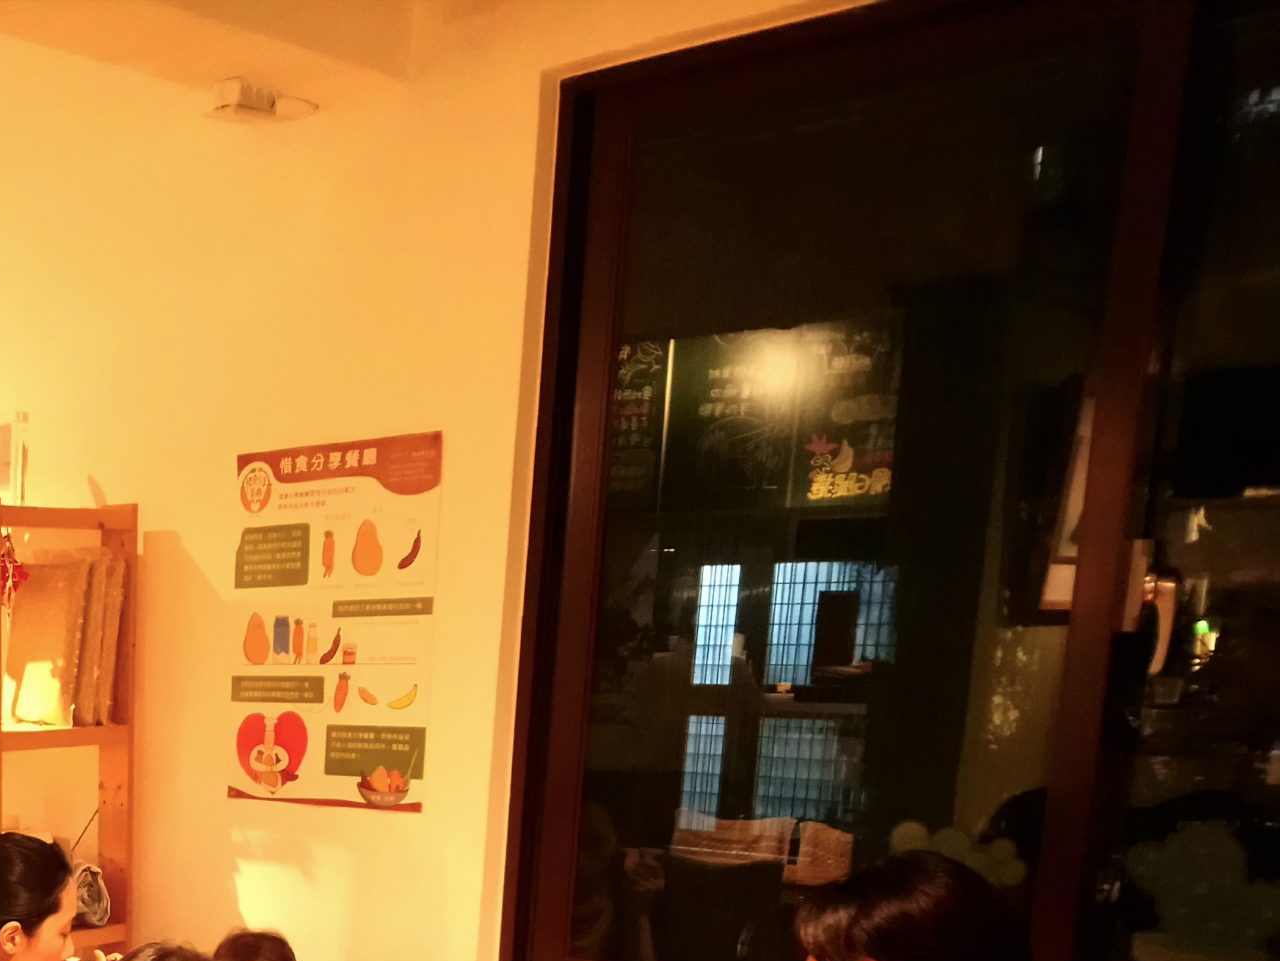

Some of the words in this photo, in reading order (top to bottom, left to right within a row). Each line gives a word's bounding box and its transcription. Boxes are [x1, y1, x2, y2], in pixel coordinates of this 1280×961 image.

[279, 447, 378, 475] 惜食分享餐廳
